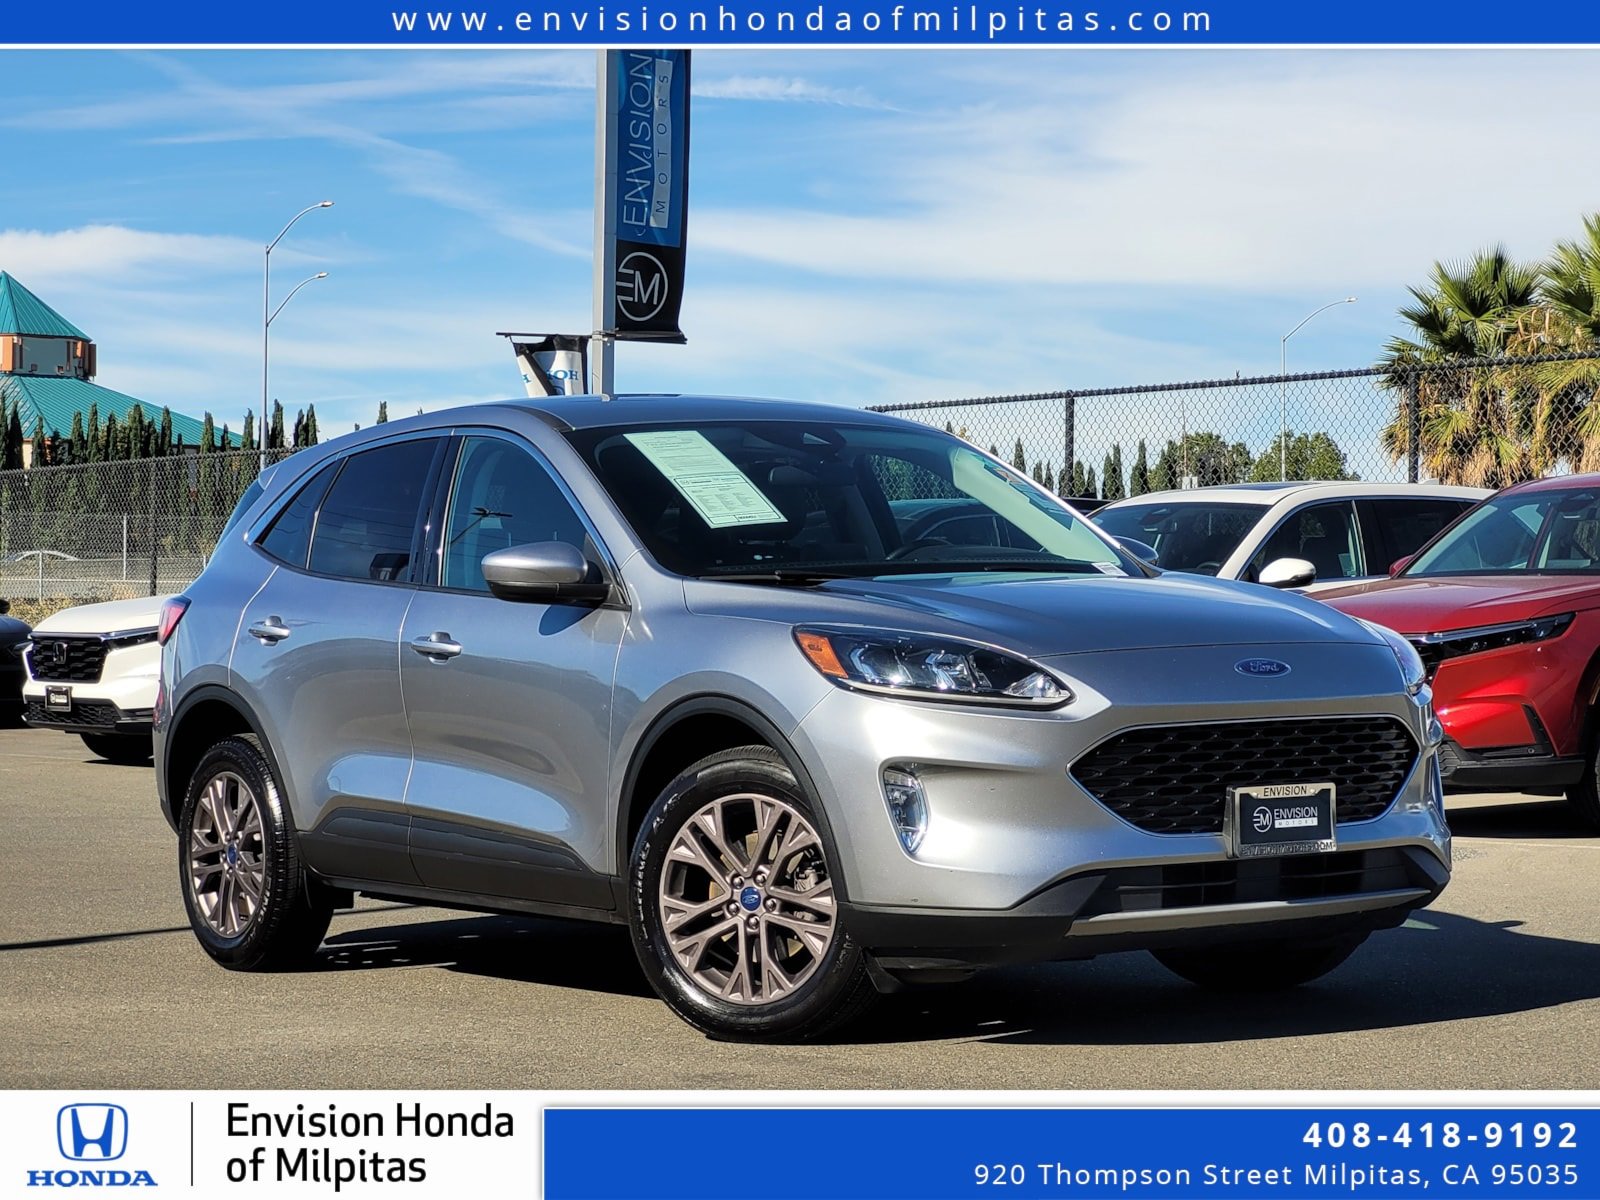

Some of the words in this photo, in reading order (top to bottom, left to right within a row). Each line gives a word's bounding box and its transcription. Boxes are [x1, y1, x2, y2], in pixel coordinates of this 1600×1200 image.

[622, 52, 653, 227] ENVISION
[655, 74, 669, 214] MOTORS
[1249, 660, 1280, 673] Ford
[1263, 785, 1308, 797] ENVISION
[1274, 807, 1318, 819] ENVISION
